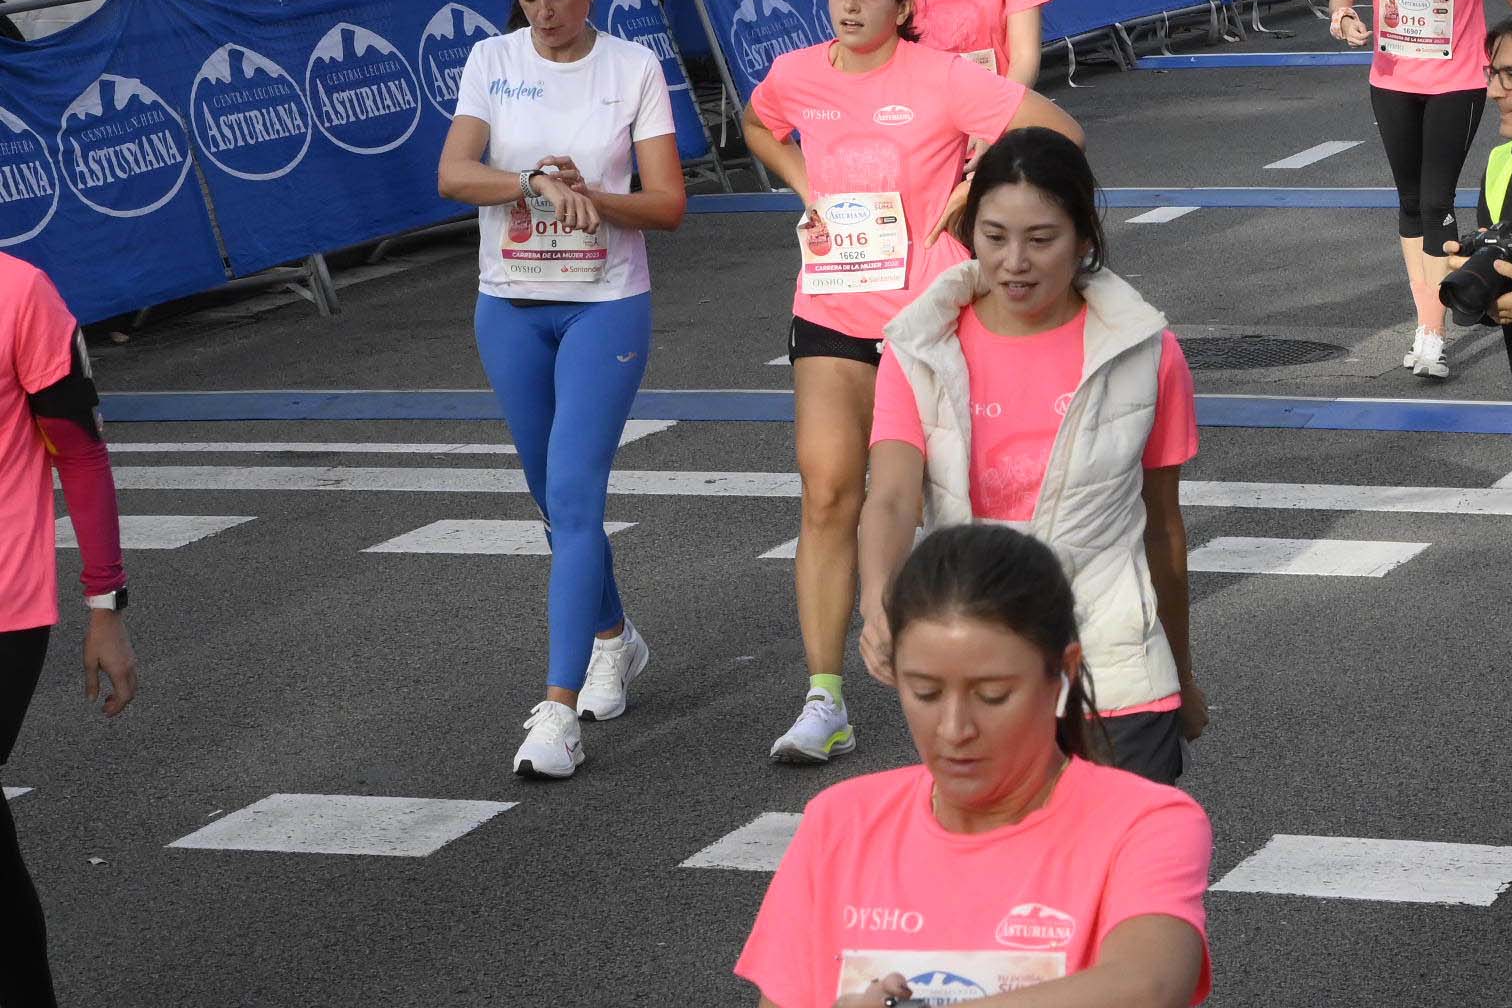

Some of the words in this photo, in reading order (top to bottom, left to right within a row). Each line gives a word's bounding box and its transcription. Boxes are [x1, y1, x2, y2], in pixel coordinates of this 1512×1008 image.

[1401, 15, 1426, 27] 016
[327, 67, 364, 86] CENTRAL
[489, 79, 544, 106] Marlene
[316, 78, 416, 128] ASTURIANA
[802, 109, 841, 122] OYSHO
[203, 100, 306, 153] ASTURIANA
[834, 232, 868, 247] 016
[839, 250, 866, 261] 16626
[511, 264, 542, 274] OYSHO
